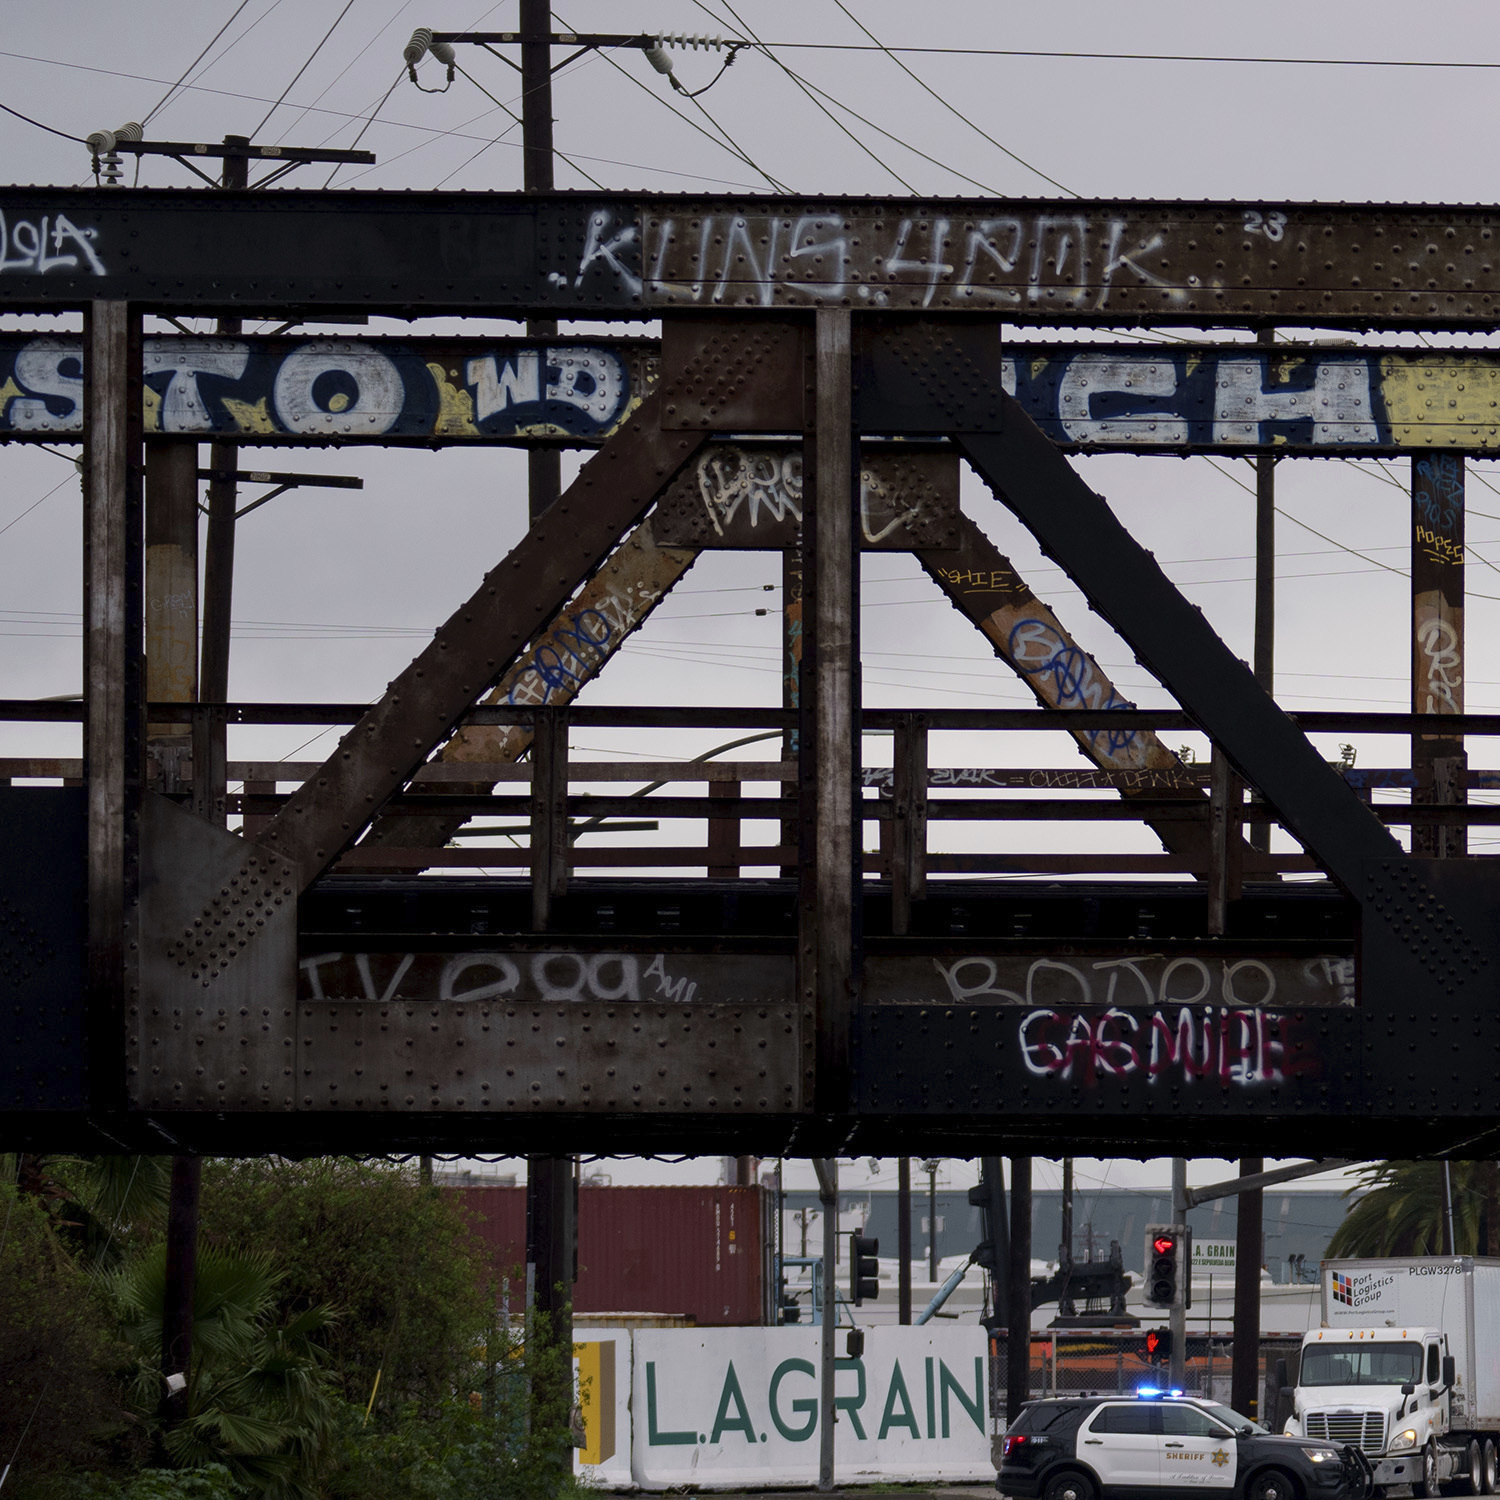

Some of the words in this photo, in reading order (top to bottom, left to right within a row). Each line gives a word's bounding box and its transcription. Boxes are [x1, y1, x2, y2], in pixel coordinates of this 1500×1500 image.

[1192, 1244, 1205, 1257] .A.
[1207, 1244, 1235, 1257] GRAIN
[1409, 1266, 1462, 1276] PLGW3278
[1353, 1273, 1373, 1287] Port
[1353, 1275, 1394, 1298] Logistics
[1354, 1290, 1382, 1307] Group
[1166, 1453, 1205, 1461] SHERIFF
